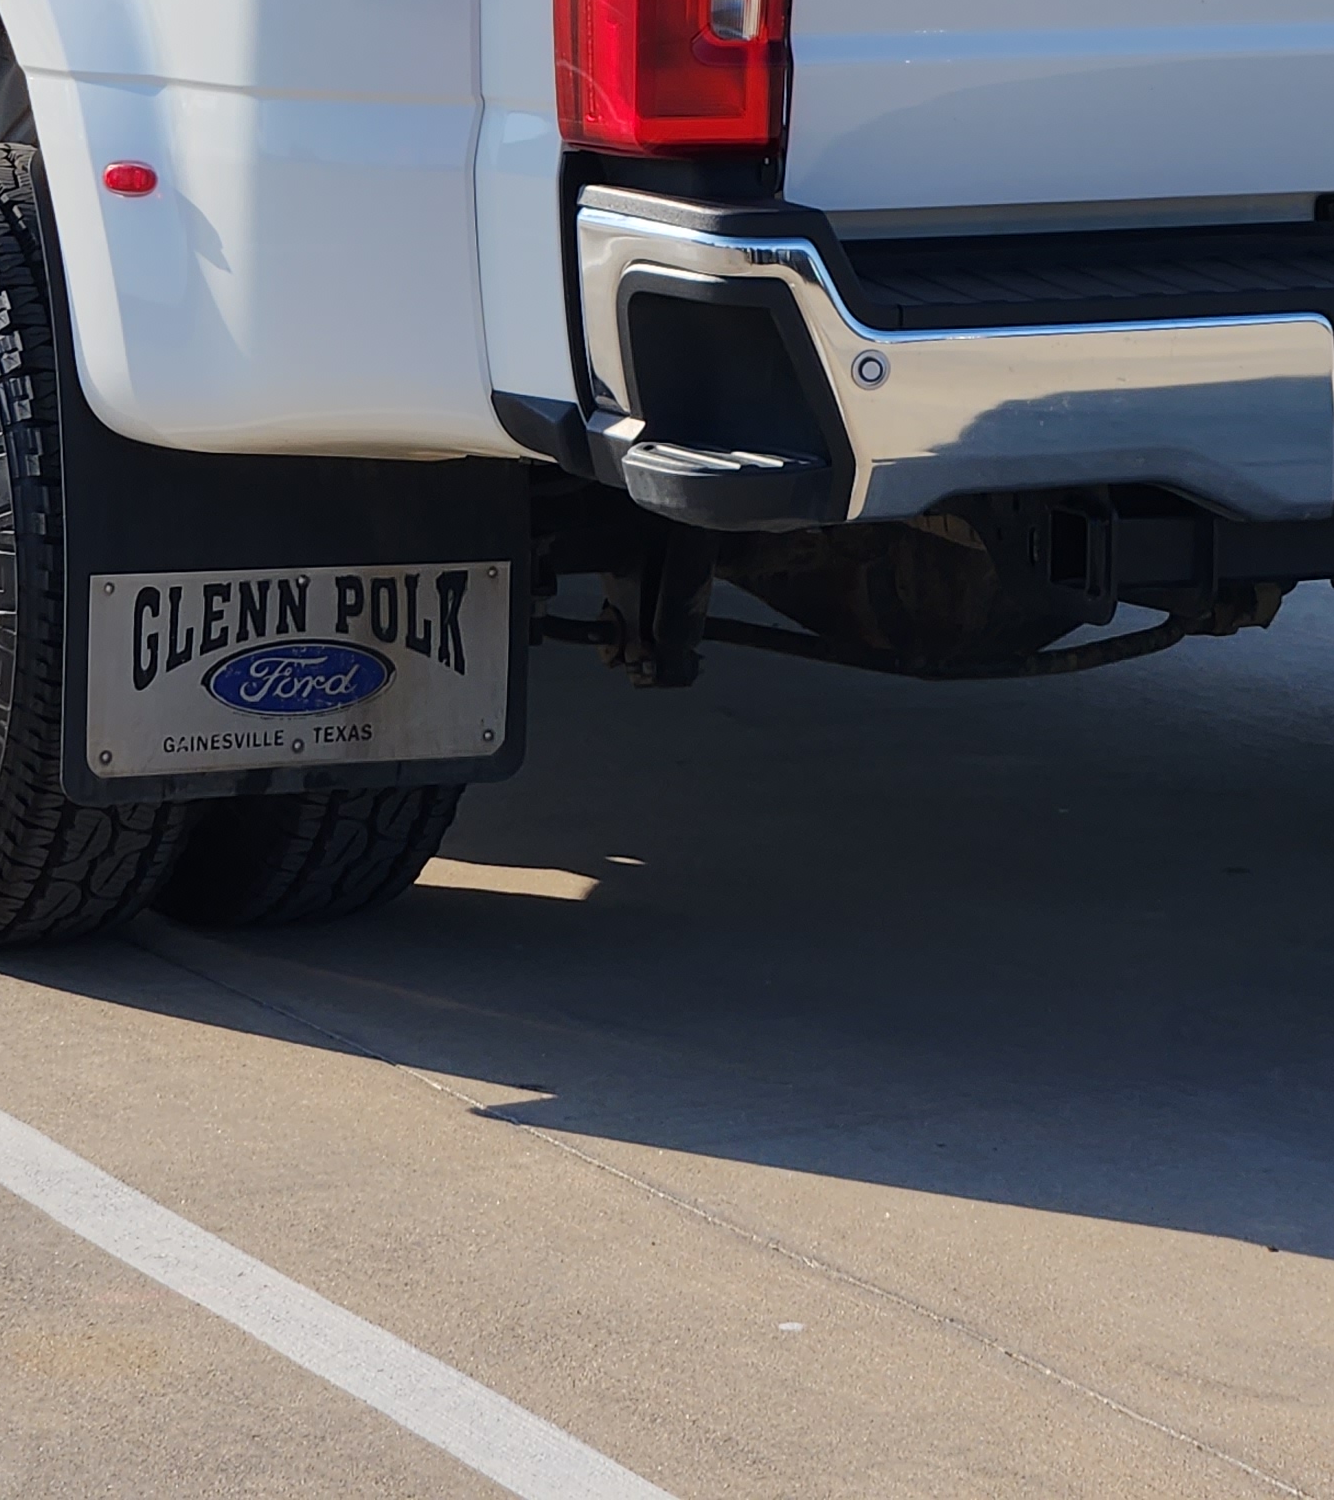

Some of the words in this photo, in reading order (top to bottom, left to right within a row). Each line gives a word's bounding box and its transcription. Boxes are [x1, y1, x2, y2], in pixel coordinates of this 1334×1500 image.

[133, 576, 309, 691] GLENN
[334, 569, 468, 676] POLK
[239, 655, 360, 703] Ford
[163, 729, 285, 754] GAINESVILLE
[313, 724, 374, 744] TEXAS
